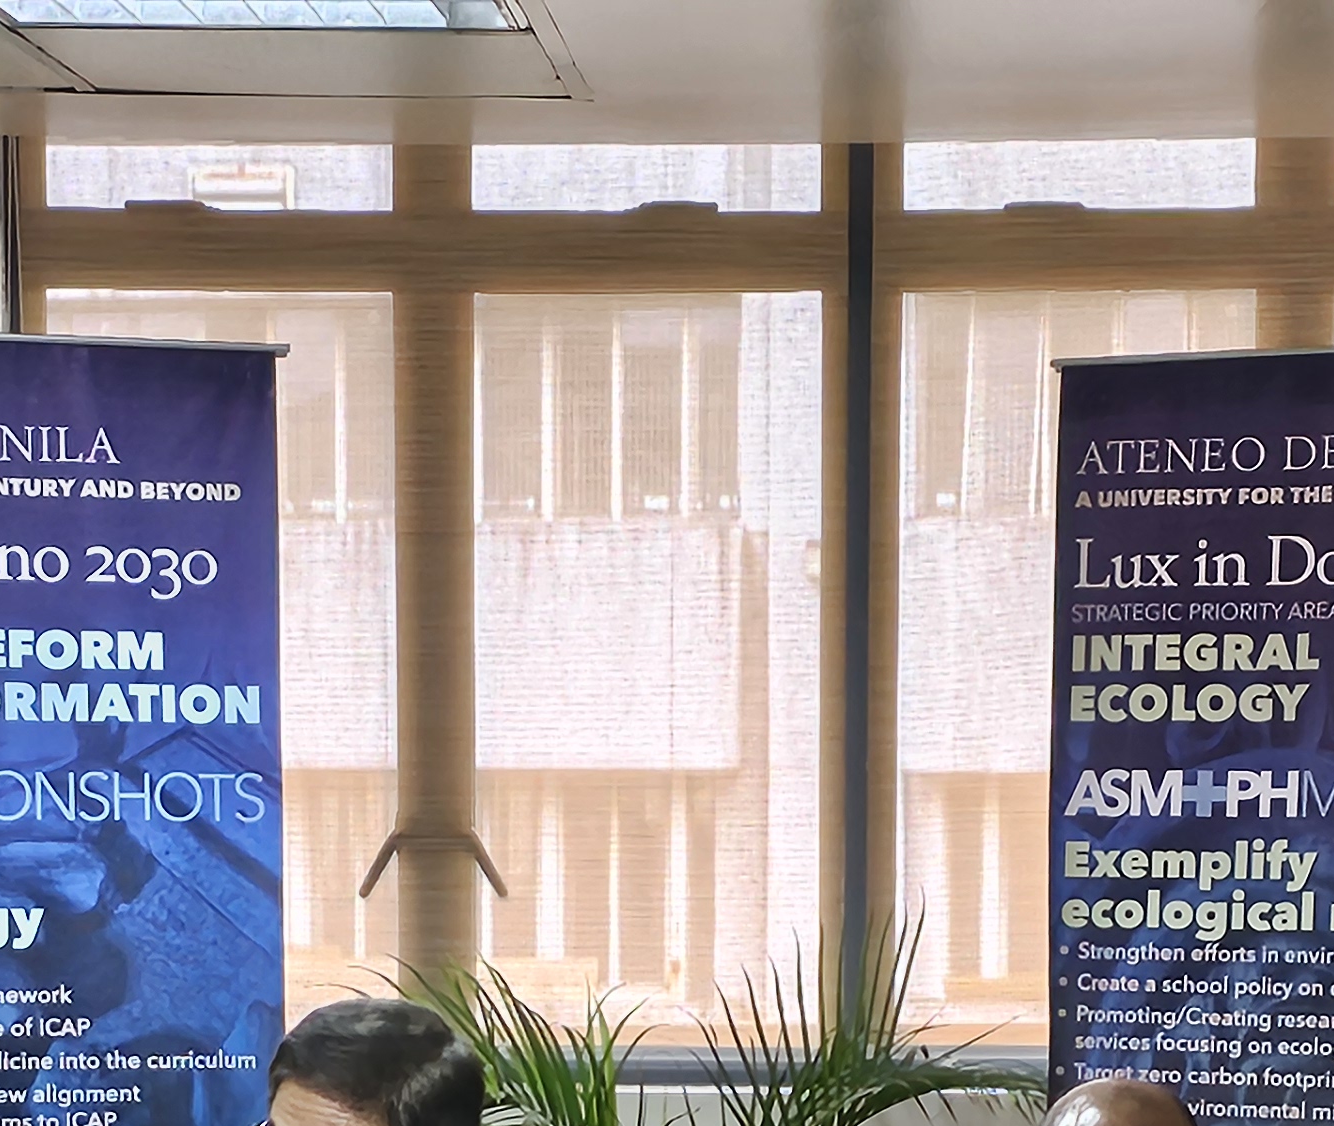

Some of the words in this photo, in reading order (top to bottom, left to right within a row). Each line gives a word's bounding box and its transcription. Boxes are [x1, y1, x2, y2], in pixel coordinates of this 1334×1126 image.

[1077, 436, 1265, 476] ATENEO
[81, 480, 133, 499] AND
[140, 482, 241, 502] BEYOND
[1098, 487, 1232, 508] UNIVERSITY
[1237, 486, 1284, 505] FOR
[1290, 485, 1333, 504] THE
[84, 546, 219, 599] 2030
[1075, 538, 1181, 589] Lux
[1194, 539, 1247, 587] in
[1072, 602, 1183, 623] STRATEGIC
[1189, 601, 1284, 621] PRIORITY
[1072, 632, 1319, 672] INTEGRAL
[1070, 683, 1311, 723] ECOLOGY
[1064, 838, 1318, 892] Exemplify
[1061, 890, 1315, 941] ecological
[1077, 941, 1185, 965] Strengthen
[1190, 942, 1257, 964] efforts
[1261, 945, 1279, 964] in
[1077, 974, 1139, 994] Create
[1162, 975, 1228, 996] school
[1234, 976, 1293, 1000] policy
[1298, 982, 1324, 998] on
[9, 1017, 33, 1037] of
[39, 1018, 91, 1036] ICAP
[1076, 1005, 1272, 1033] Promoting/Creating
[1075, 1034, 1150, 1052] services
[1155, 1033, 1242, 1058] focusing
[1247, 1039, 1273, 1055] on
[59, 1051, 100, 1070] into
[105, 1050, 140, 1070] the
[146, 1050, 256, 1070] curriculum
[1137, 1068, 1182, 1085] zero
[1188, 1065, 1258, 1087] carbon
[33, 1083, 141, 1105] alignment
